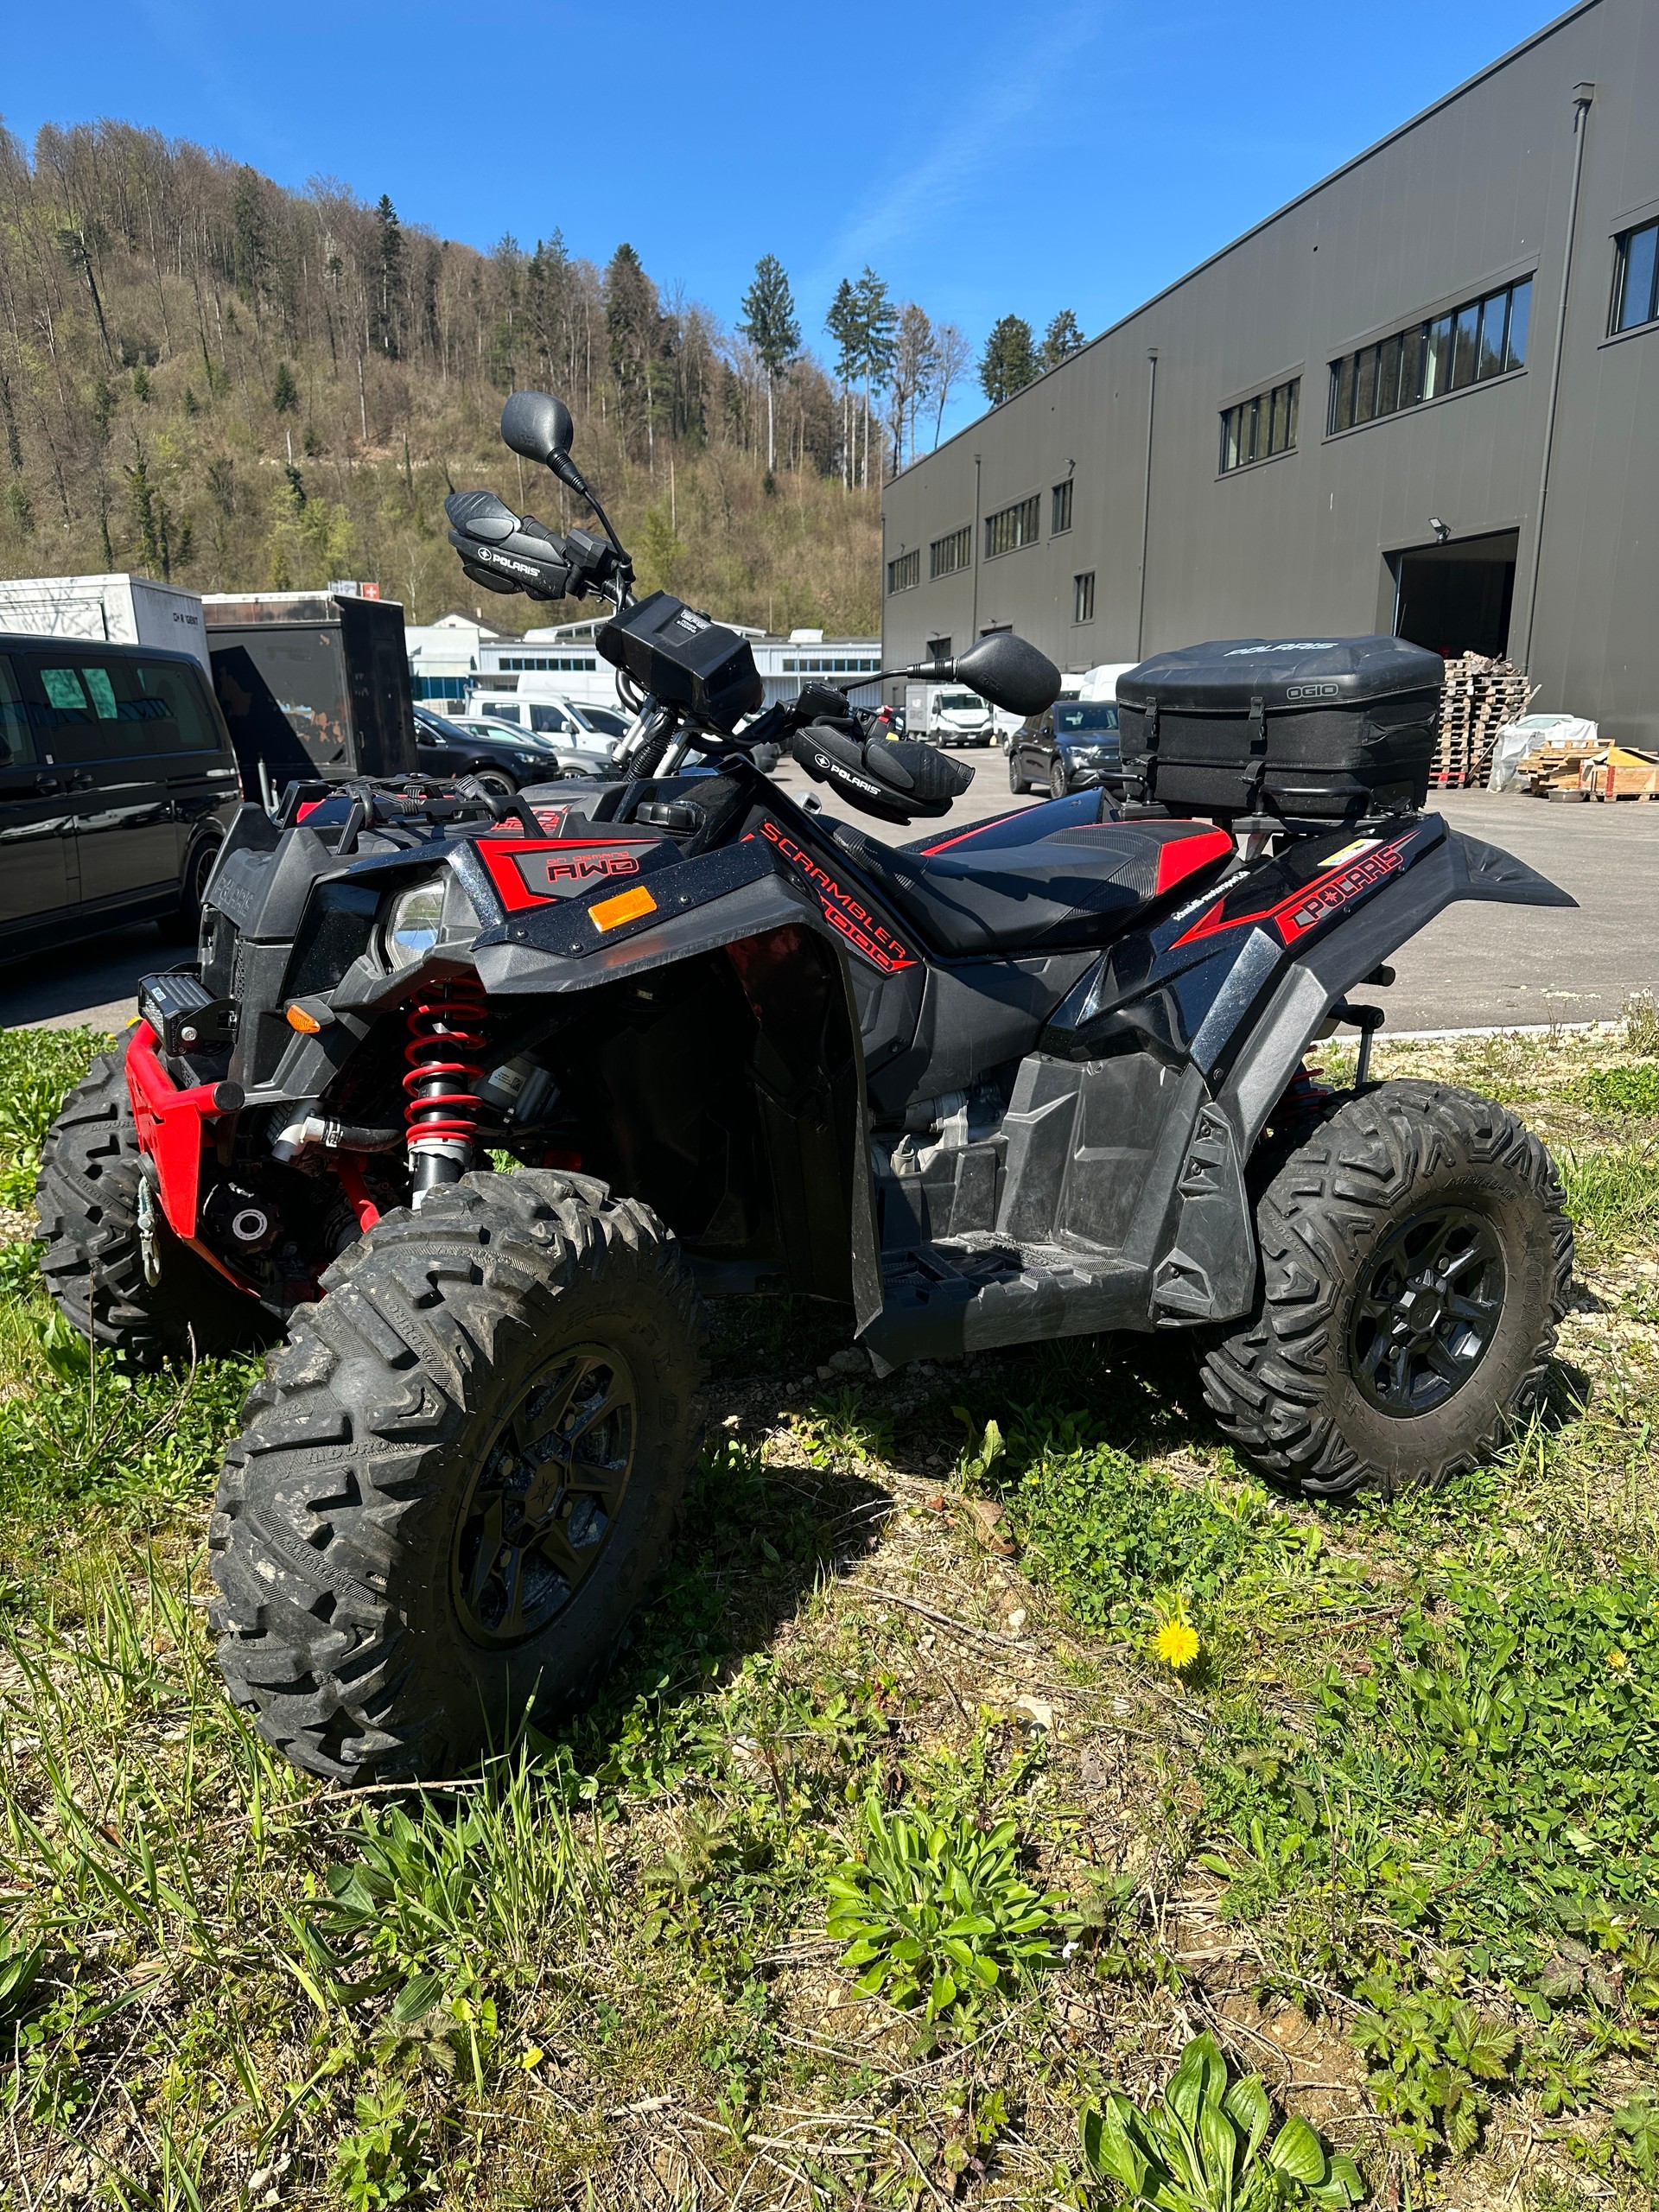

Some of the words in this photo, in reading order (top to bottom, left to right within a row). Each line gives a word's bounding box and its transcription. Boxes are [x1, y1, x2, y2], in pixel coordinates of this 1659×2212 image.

[493, 554, 541, 577] POLARIS
[1223, 642, 1339, 657] POLARIS
[1287, 683, 1338, 700] OGIO
[830, 764, 881, 795] POLARIS
[572, 851, 629, 861] DEMAND
[546, 856, 639, 883] AWD
[760, 822, 906, 959] SCRAMBLER
[1301, 845, 1404, 921] POLARIS
